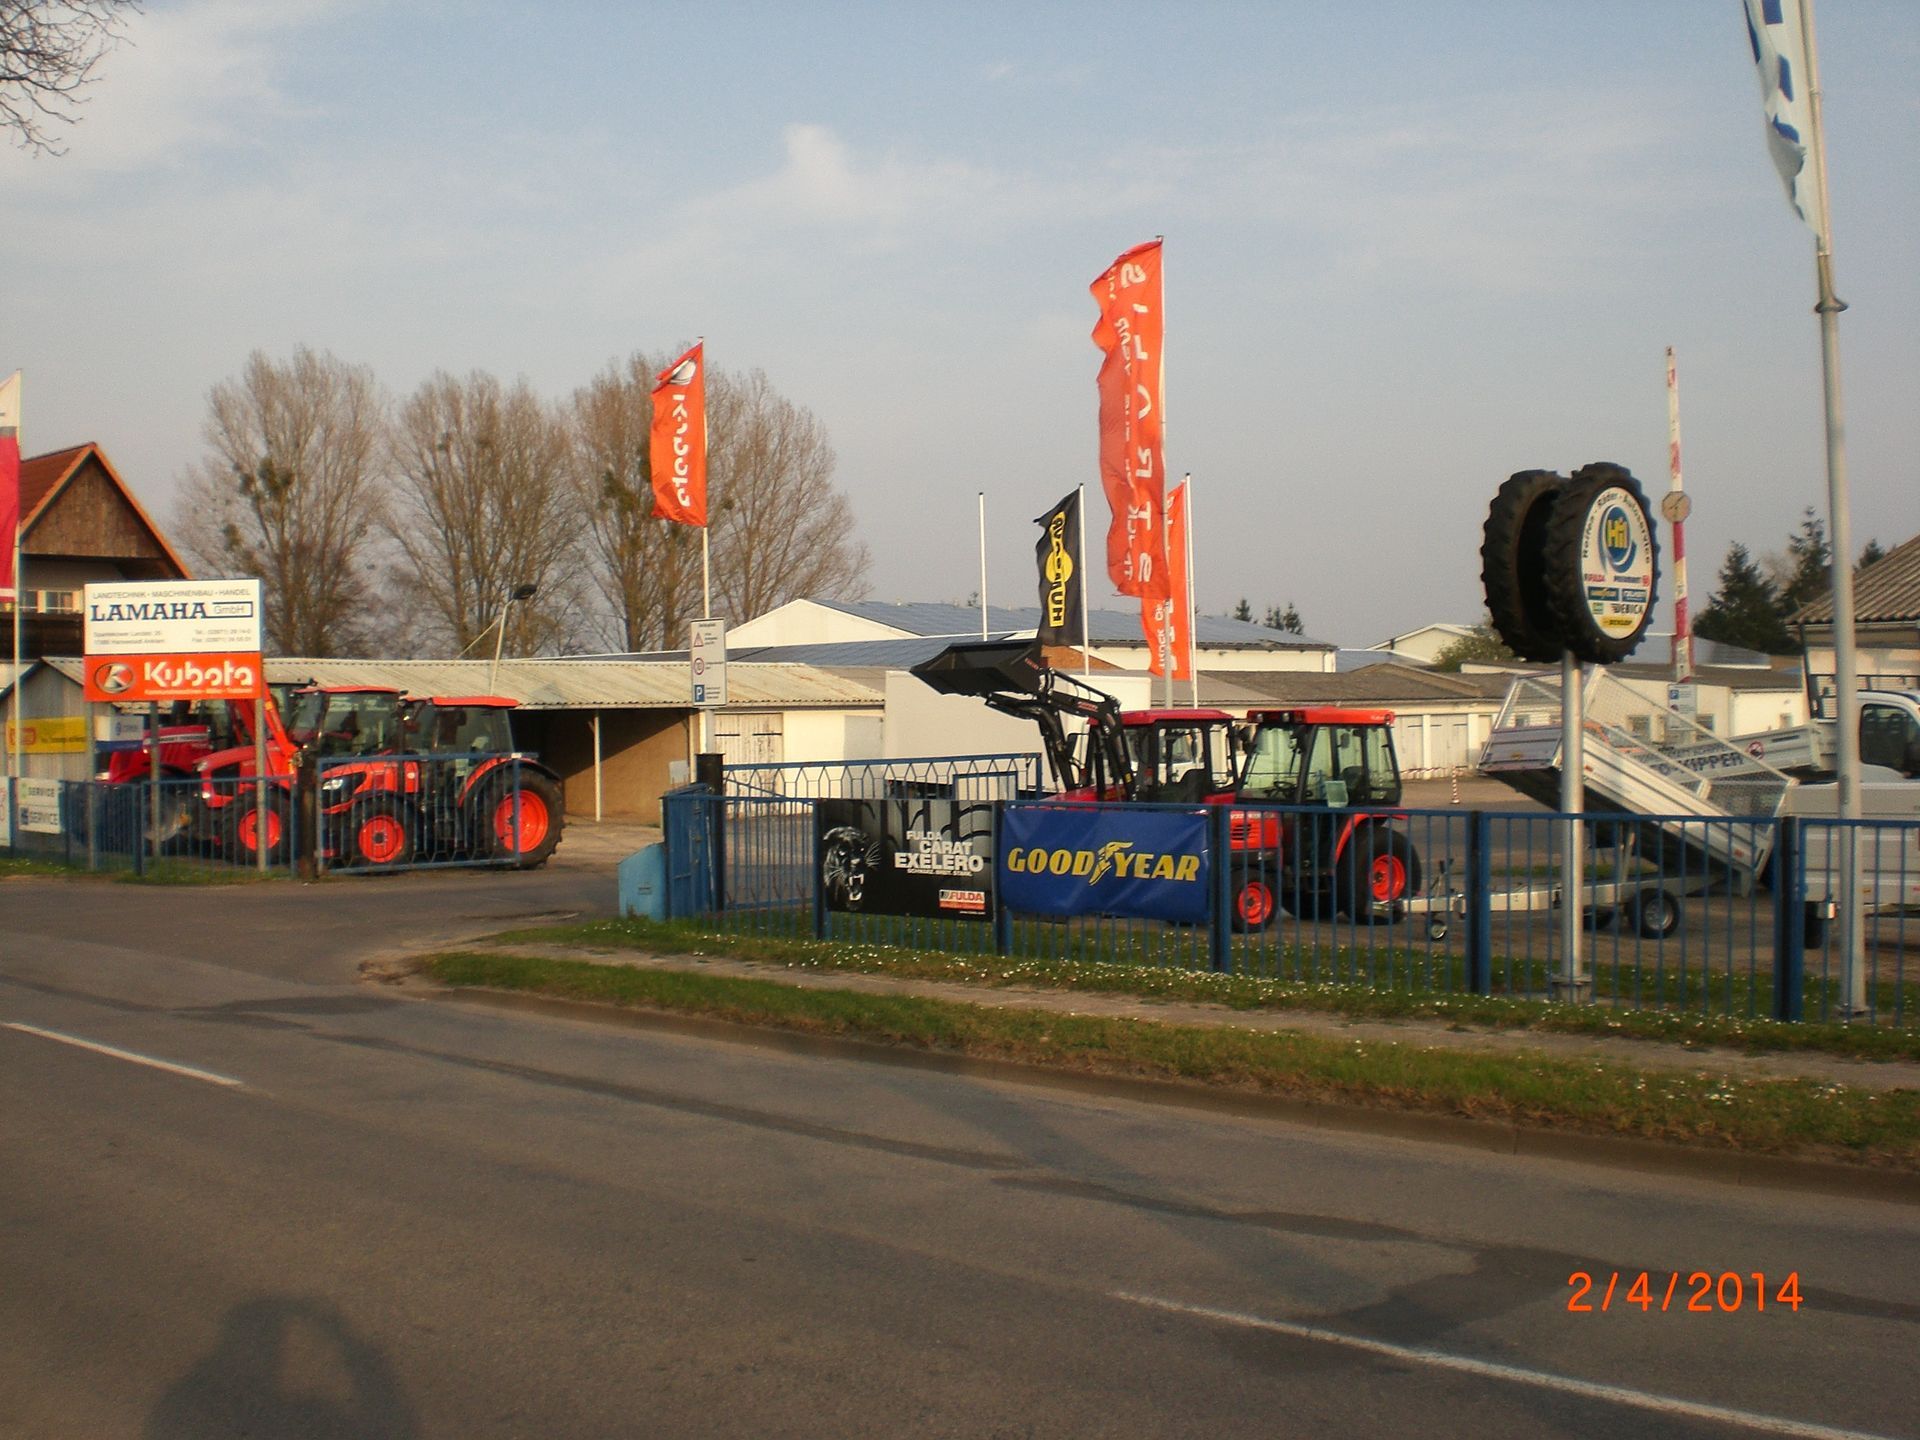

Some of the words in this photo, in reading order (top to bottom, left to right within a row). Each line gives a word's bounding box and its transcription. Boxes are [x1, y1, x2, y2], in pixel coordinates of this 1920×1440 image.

[218, 588, 251, 597] HANDEL
[90, 602, 207, 621] LAMAHA
[214, 604, 245, 615] GmbH
[143, 660, 254, 688] Kubota
[906, 830, 942, 840] FULDA
[919, 841, 973, 855] CARAT
[894, 852, 984, 872] EXELERO
[949, 892, 984, 901] FULDA
